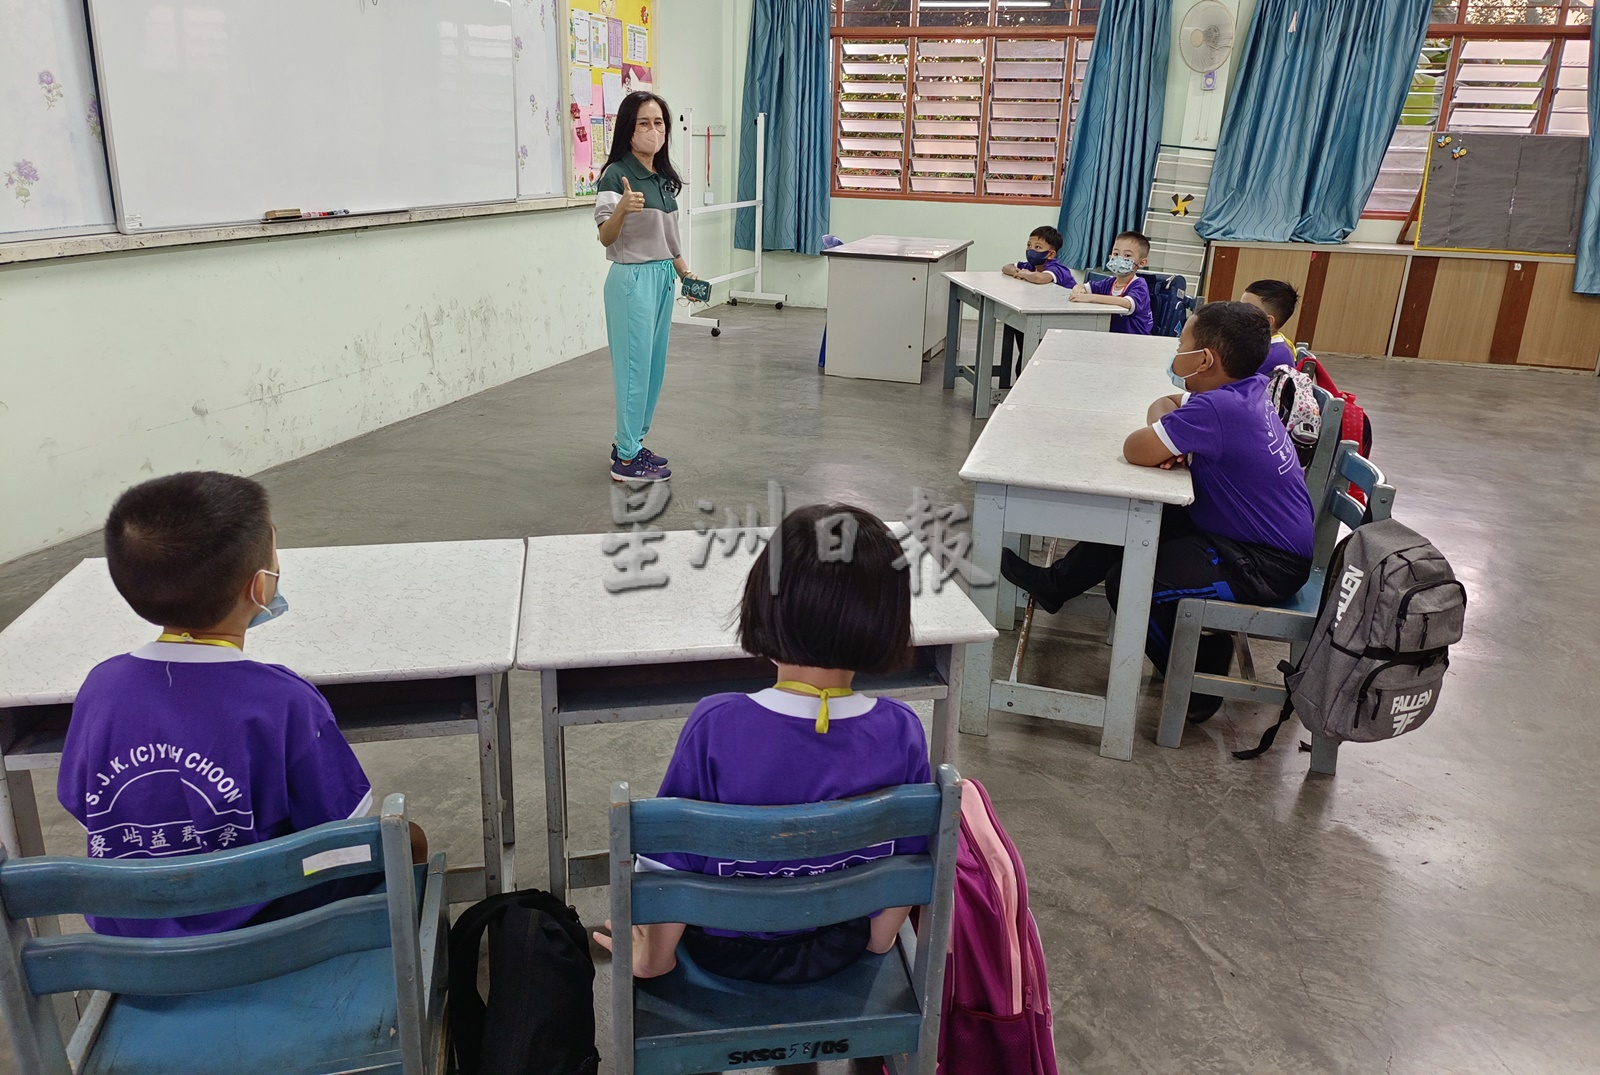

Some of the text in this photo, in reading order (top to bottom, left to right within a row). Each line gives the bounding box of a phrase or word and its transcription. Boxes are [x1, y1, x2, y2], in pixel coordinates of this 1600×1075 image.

[1334, 564, 1364, 628] ALLEN
[1389, 688, 1433, 715] FALLEN
[185, 752, 243, 804] CHOON
